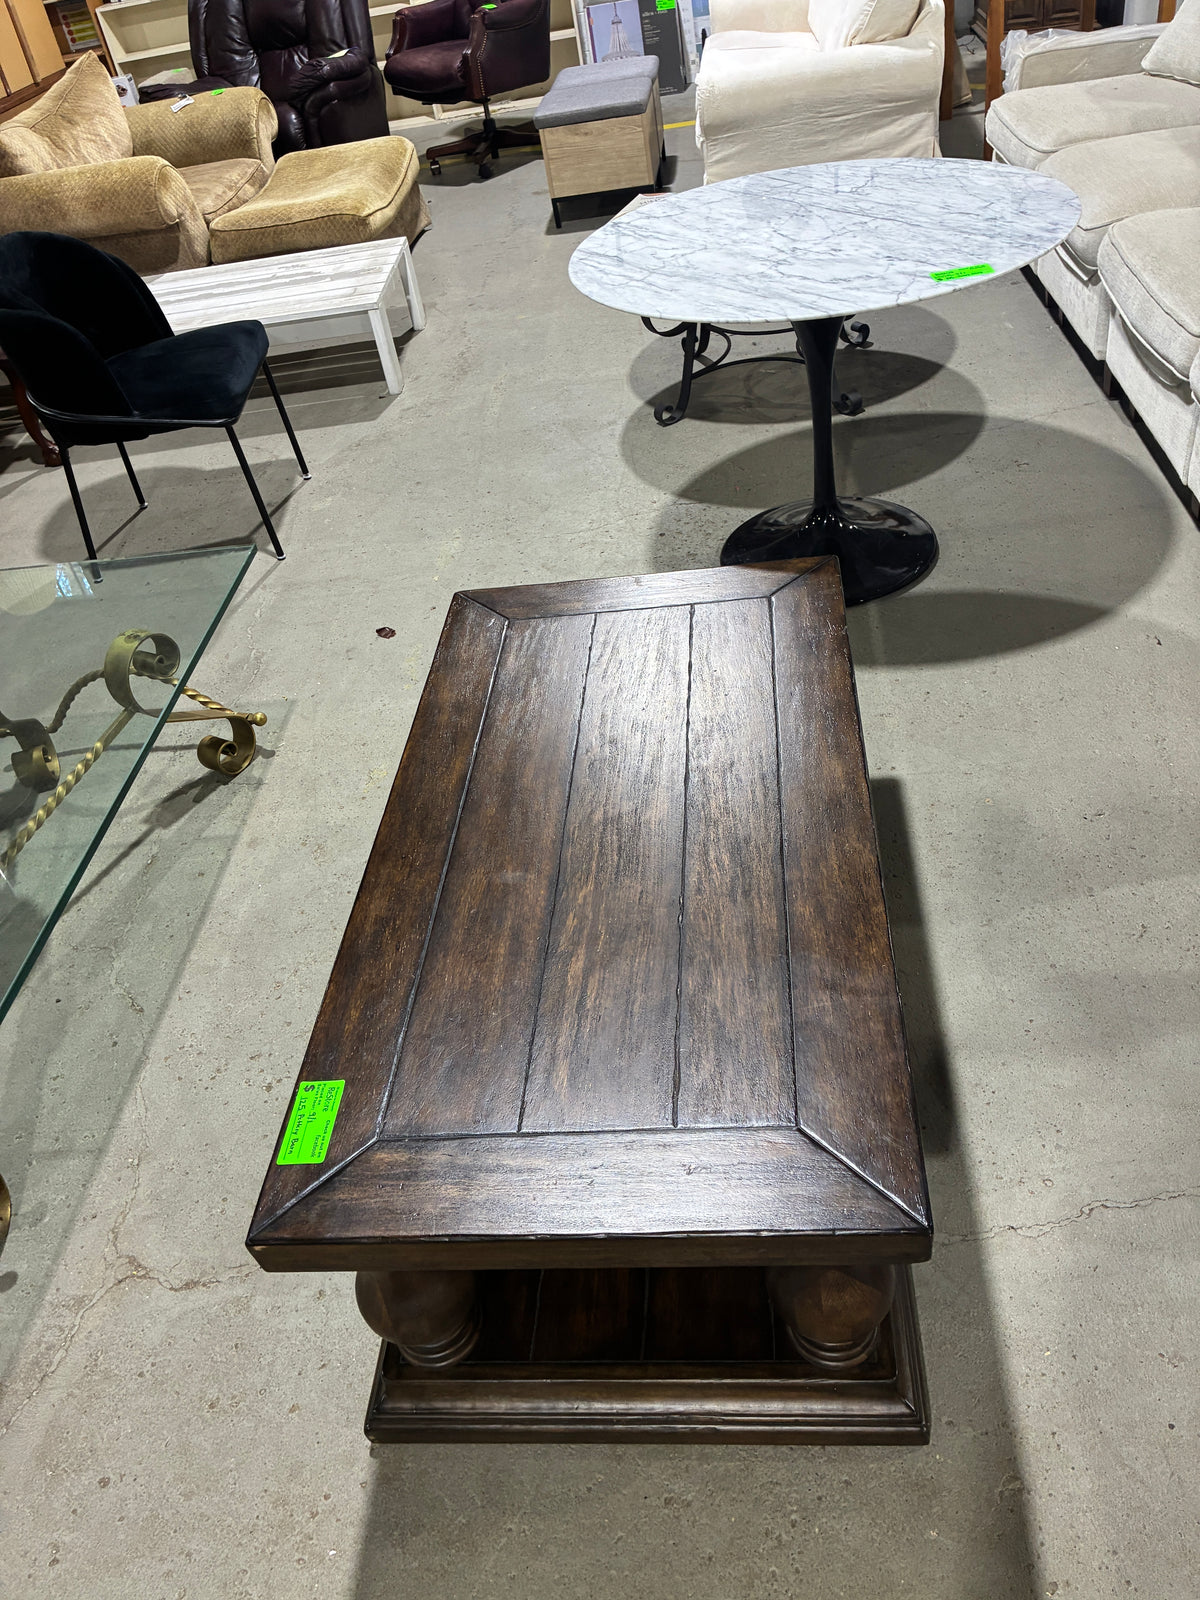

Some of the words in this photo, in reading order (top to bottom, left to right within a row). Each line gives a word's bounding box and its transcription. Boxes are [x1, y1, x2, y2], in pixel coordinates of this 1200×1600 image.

[298, 1097, 307, 1111] 125
[323, 1087, 335, 1112] ReStore
[288, 1138, 298, 1154] Barn
